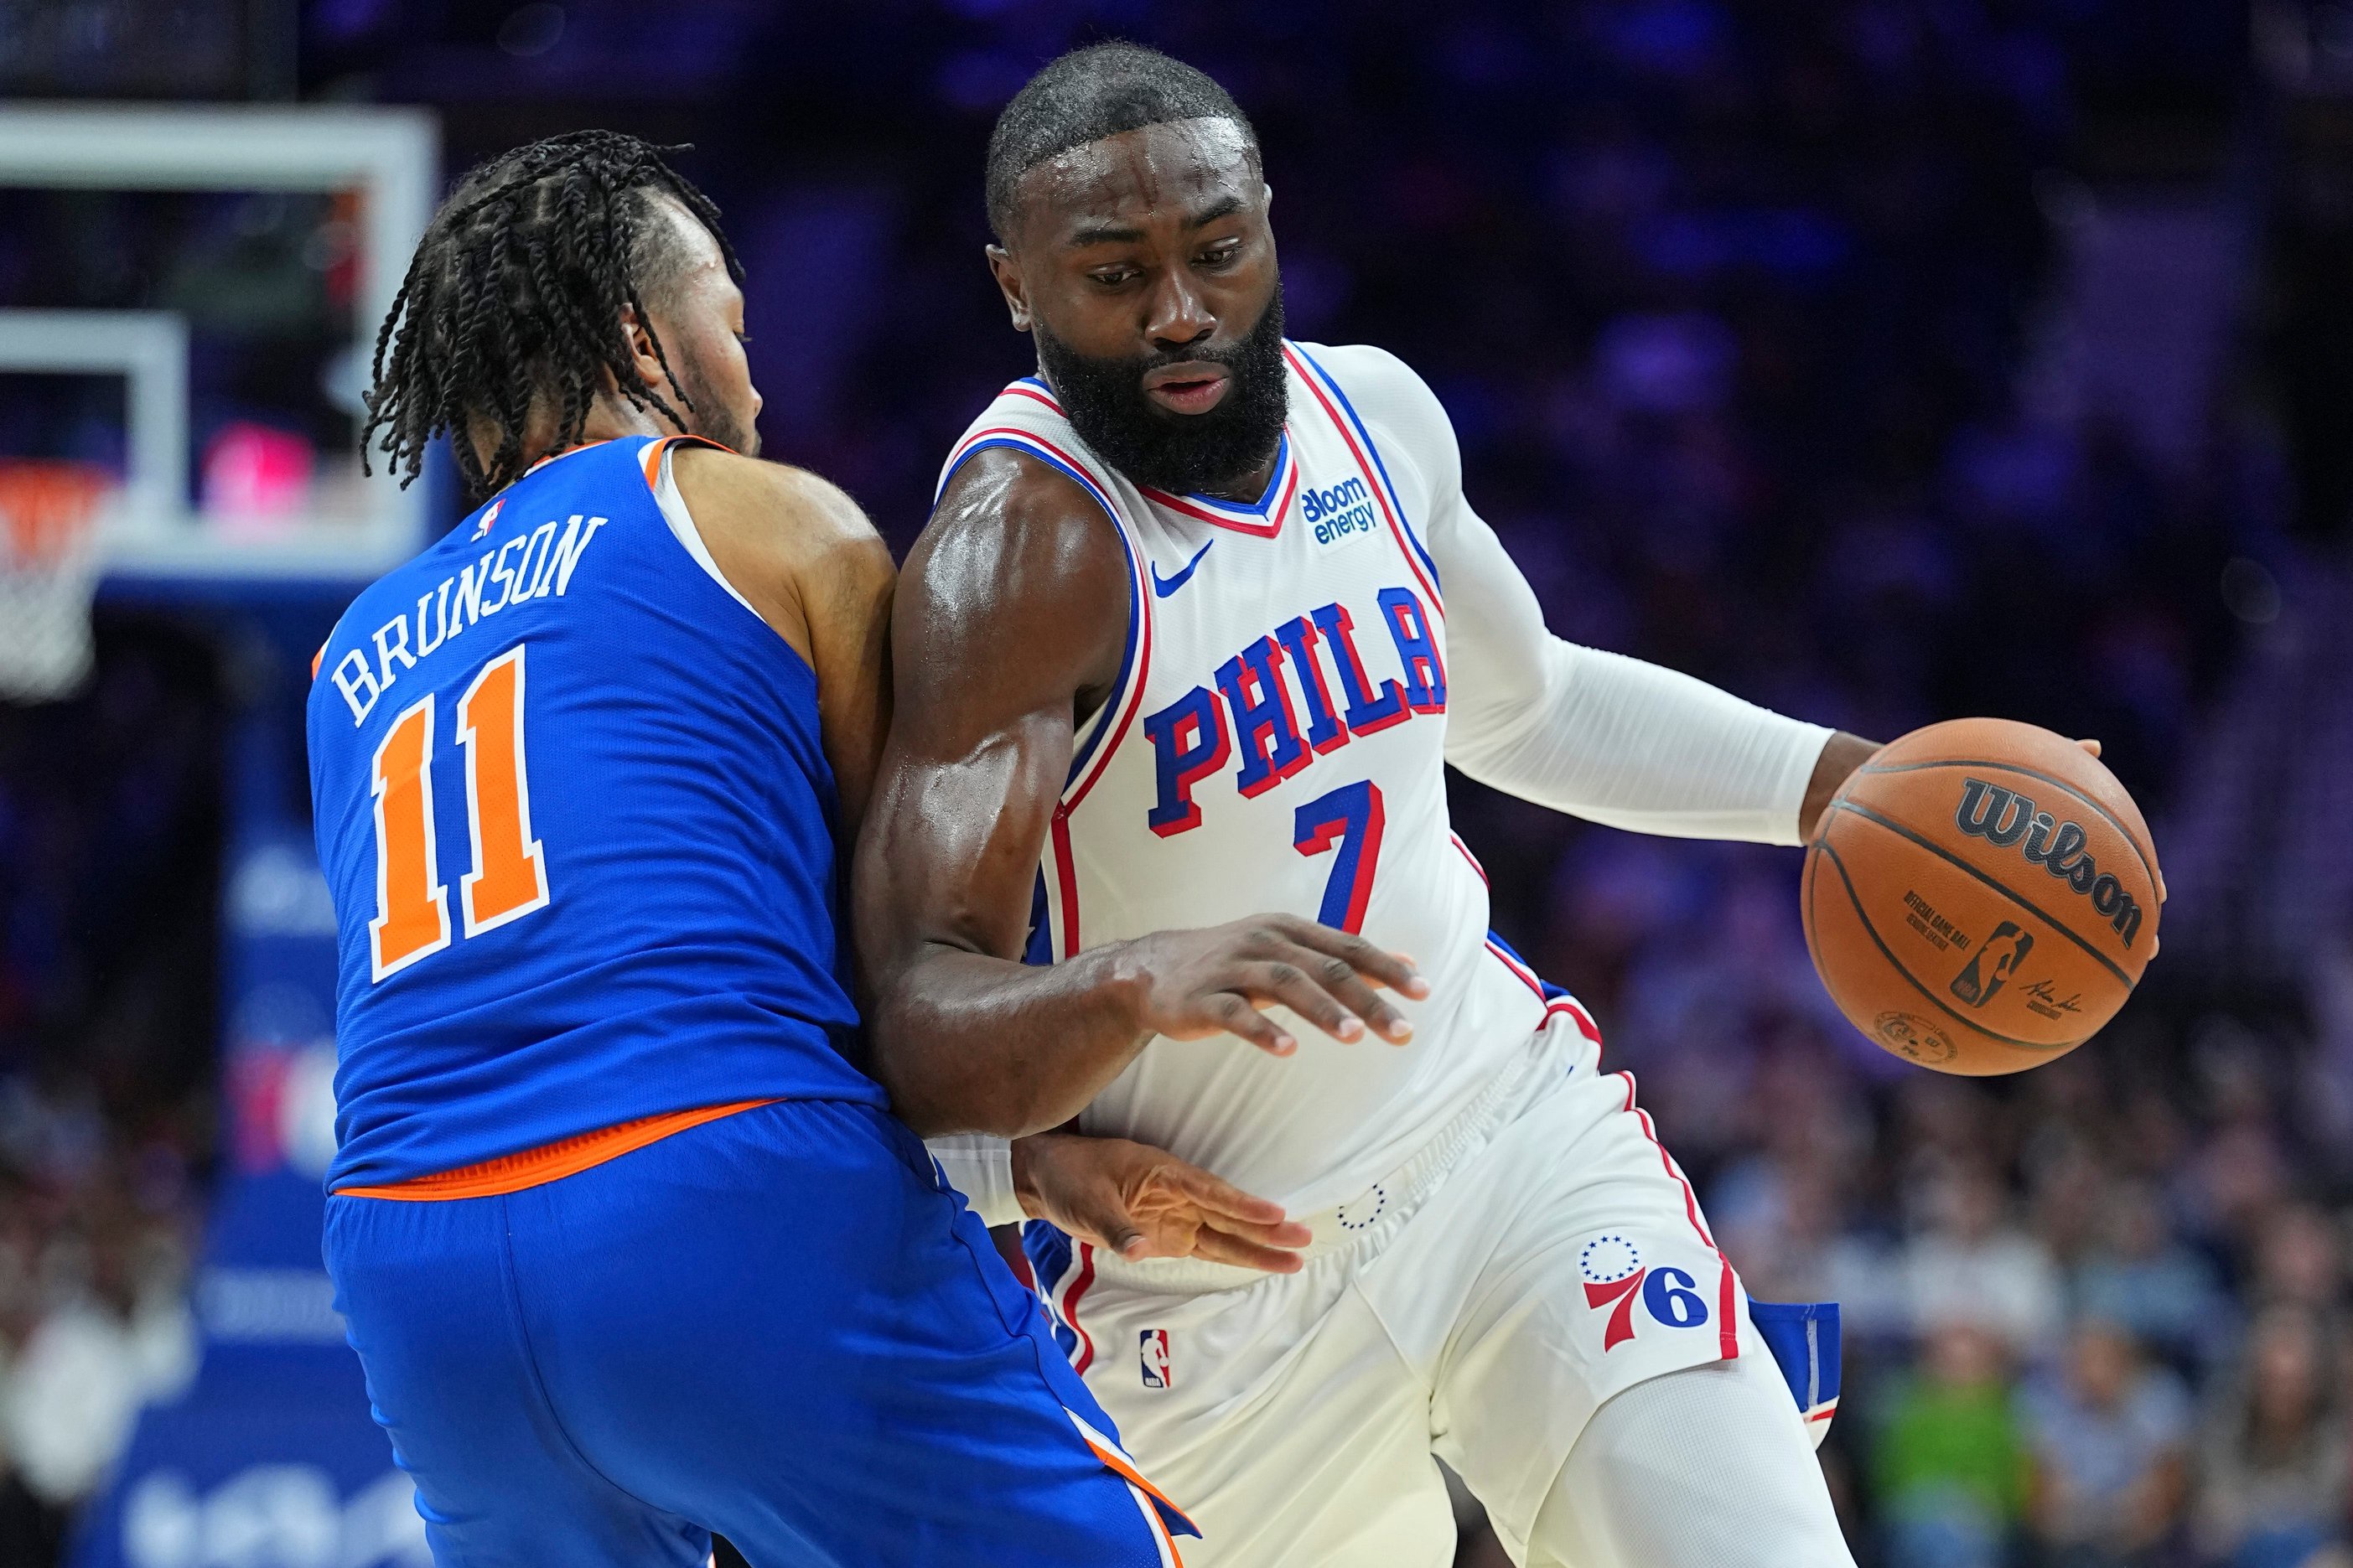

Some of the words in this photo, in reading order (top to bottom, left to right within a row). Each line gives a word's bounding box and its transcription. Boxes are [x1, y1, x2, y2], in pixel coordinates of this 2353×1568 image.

[1302, 477, 1367, 522] Bloom
[1314, 501, 1376, 545] energy
[331, 514, 609, 728] BRUNSON
[1143, 587, 1447, 839] PHILA
[368, 643, 551, 985] 11
[1293, 779, 1386, 937] 7
[1955, 778, 2143, 950] Wilson
[1904, 889, 1935, 923] OFFICIAL
[1931, 914, 1955, 939] GAME
[1950, 930, 1972, 952] BALL
[1583, 1265, 1709, 1354] 76
[1144, 1377, 1162, 1388] NBA
